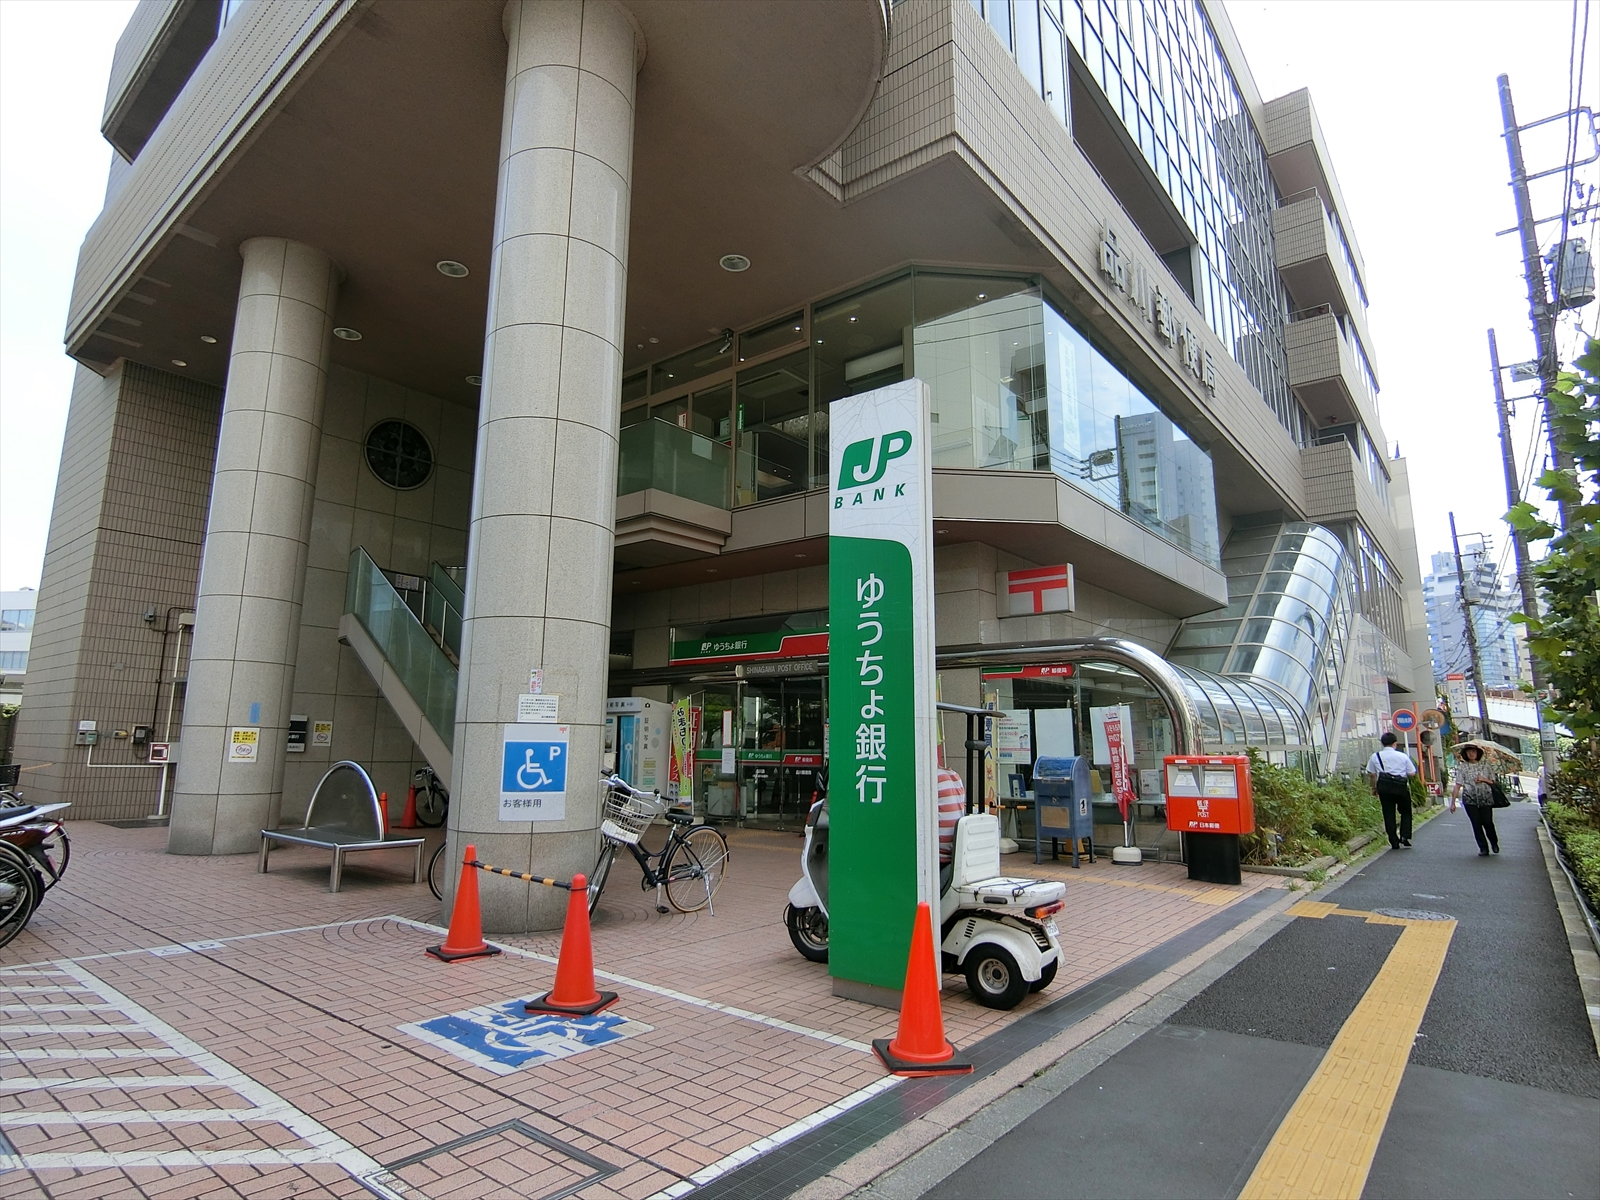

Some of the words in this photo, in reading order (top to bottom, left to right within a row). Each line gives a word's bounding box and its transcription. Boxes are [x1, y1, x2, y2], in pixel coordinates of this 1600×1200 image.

[1100, 218, 1216, 398] 品川郵便局
[838, 430, 912, 490] JP
[834, 483, 906, 509] BANK
[713, 640, 748, 651] ゆうちょ銀行
[746, 665, 776, 675] SHINAGAWA
[777, 664, 792, 673] POST
[793, 662, 813, 671] OFFICE
[855, 573, 887, 804] ゆうちょ銀行
[549, 746, 561, 761] P
[502, 798, 542, 808] お客様用
